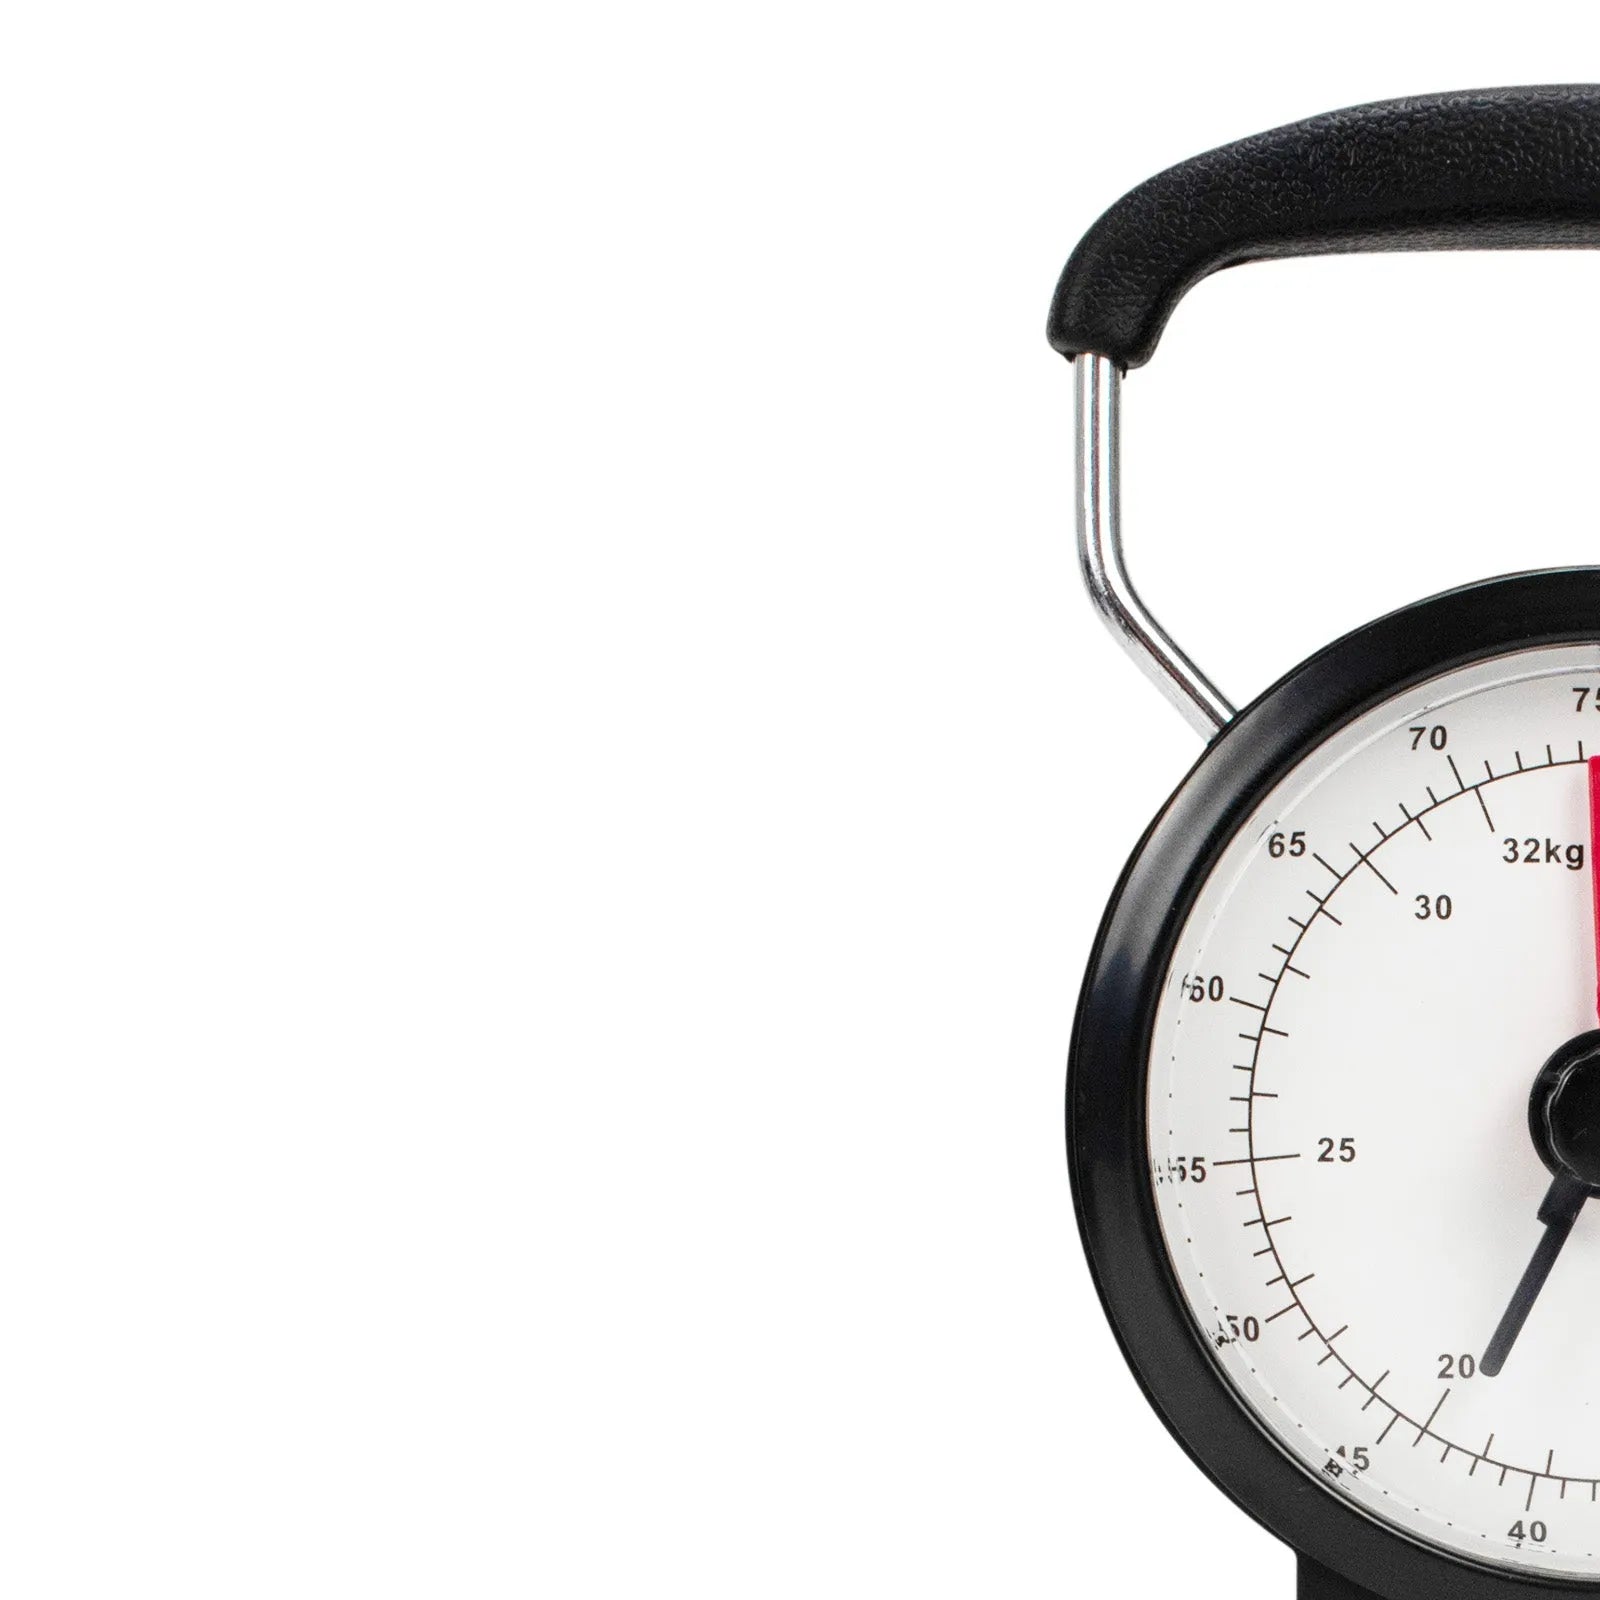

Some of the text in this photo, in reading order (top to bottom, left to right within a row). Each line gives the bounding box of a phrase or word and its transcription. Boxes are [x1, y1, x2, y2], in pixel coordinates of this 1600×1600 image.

[1409, 726, 1448, 751] 70
[1268, 832, 1307, 858] 65
[1503, 838, 1584, 870] 32kg
[1415, 895, 1452, 920] 30
[1190, 976, 1225, 1002] 60
[1318, 1138, 1356, 1163] 25
[1438, 1354, 1475, 1379] 20
[1508, 1521, 1548, 1544] 40
